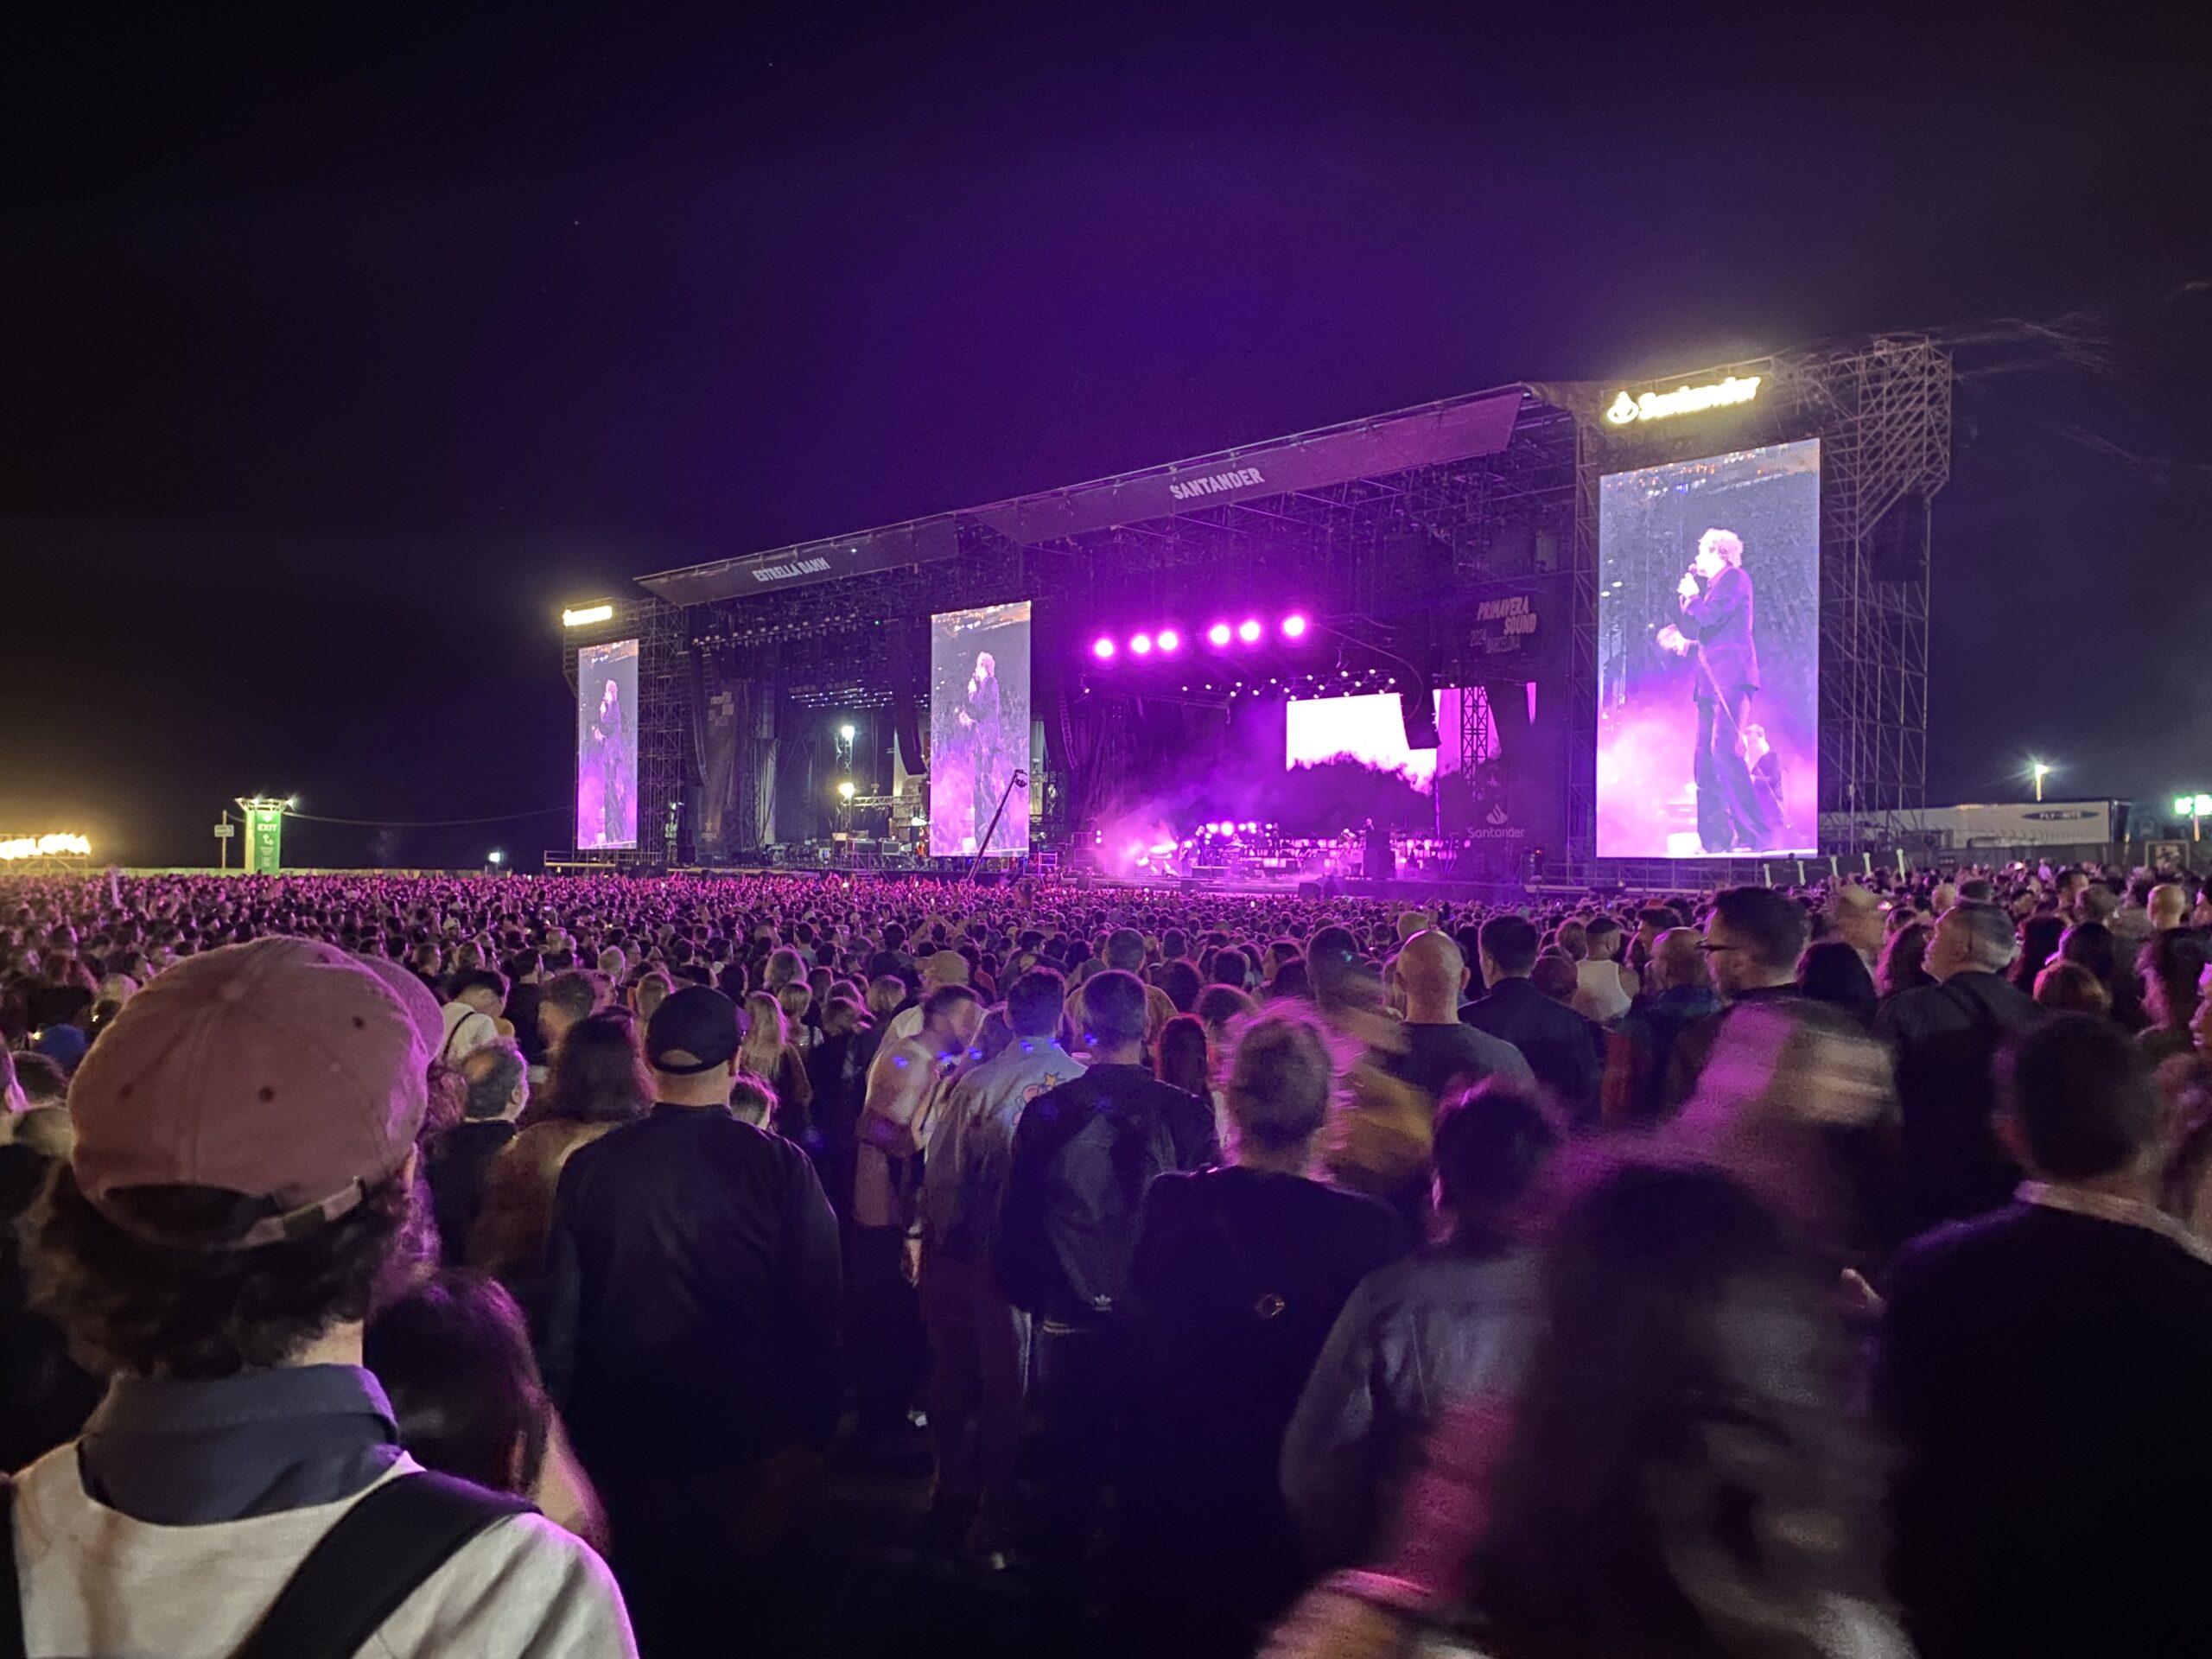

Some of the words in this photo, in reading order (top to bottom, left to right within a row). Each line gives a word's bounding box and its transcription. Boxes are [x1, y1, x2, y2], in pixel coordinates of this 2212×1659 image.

[1169, 467, 1265, 499] SANTANDER
[752, 563, 803, 582] ESTRELLA
[797, 557, 831, 574] DAMM
[1477, 595, 1529, 621] PRIMAVERA
[1503, 613, 1536, 635] SOUND
[257, 823, 277, 832] EXIT
[1467, 825, 1526, 839] Santander
